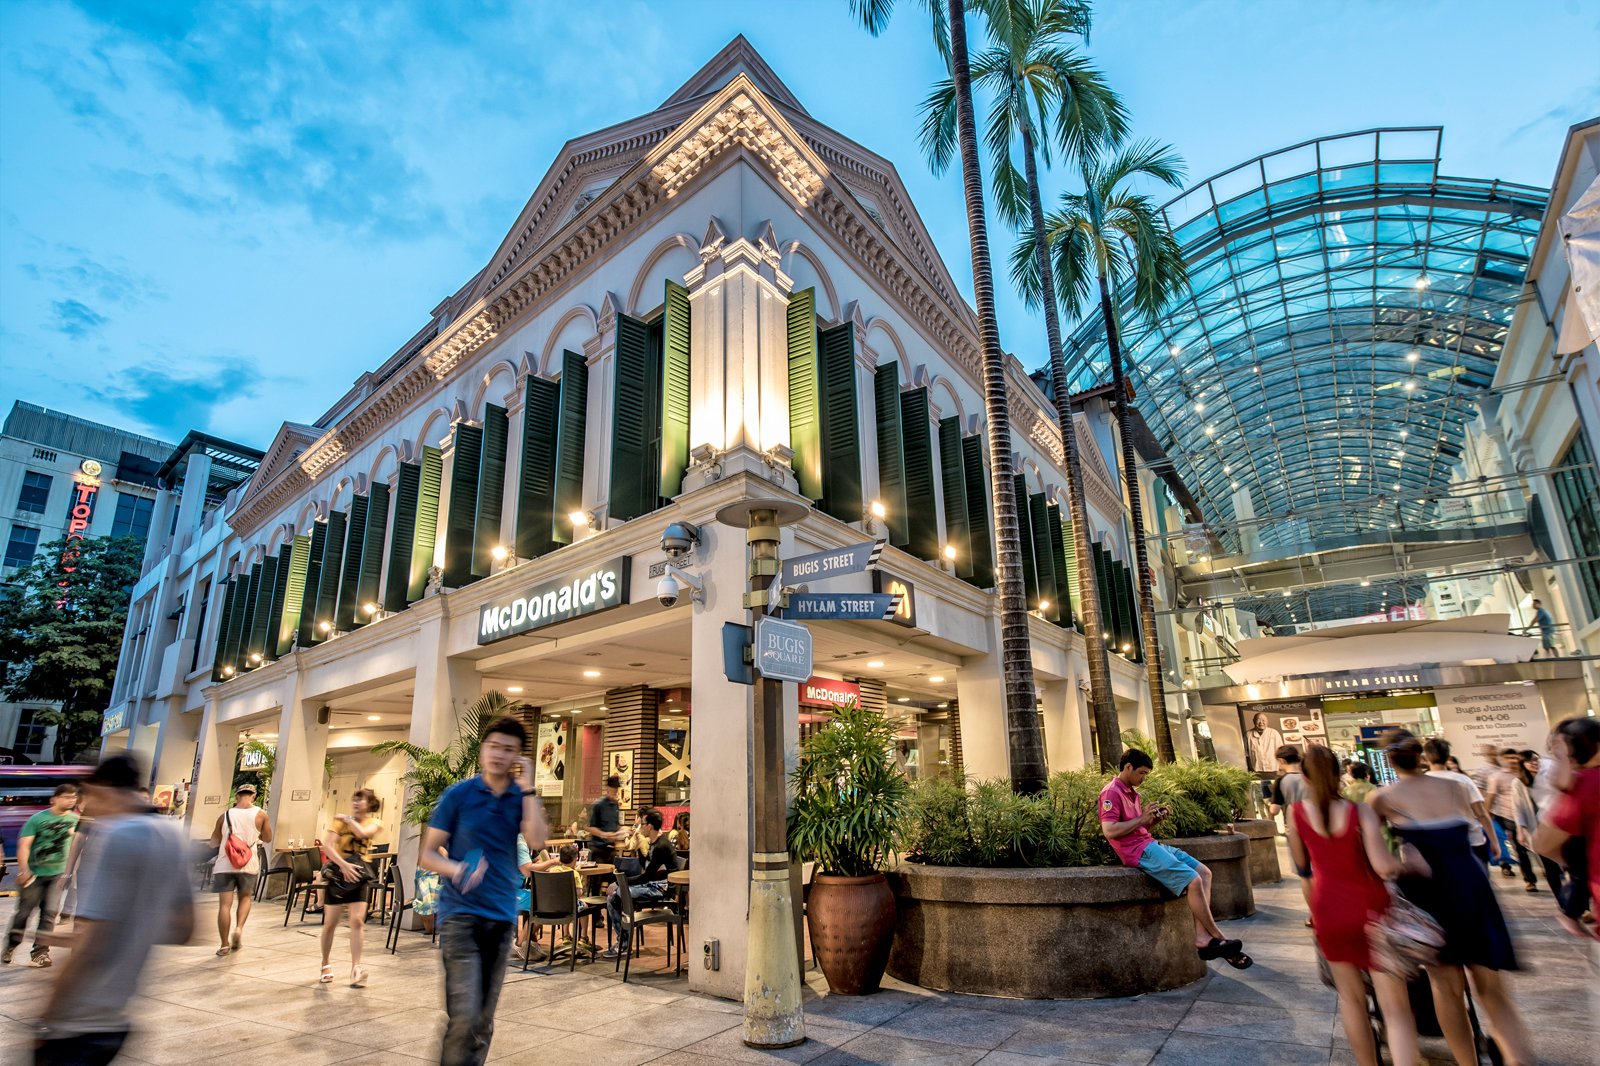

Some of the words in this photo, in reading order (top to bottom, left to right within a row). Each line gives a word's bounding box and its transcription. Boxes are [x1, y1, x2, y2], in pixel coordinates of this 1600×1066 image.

[793, 560, 819, 577] BUGIS
[823, 552, 854, 571] STREET
[481, 570, 616, 636] McDonald's
[798, 600, 836, 613] HYLAM
[840, 600, 875, 613] STREET
[767, 633, 805, 655] BUGIS
[767, 650, 805, 665] SQUARE
[1325, 678, 1370, 689] HYLAM
[1374, 674, 1419, 685] STREET
[806, 686, 858, 705] McDonald's
[1455, 706, 1482, 714] Bugis
[1483, 703, 1526, 712] Junction
[1476, 714, 1510, 722] #04-06
